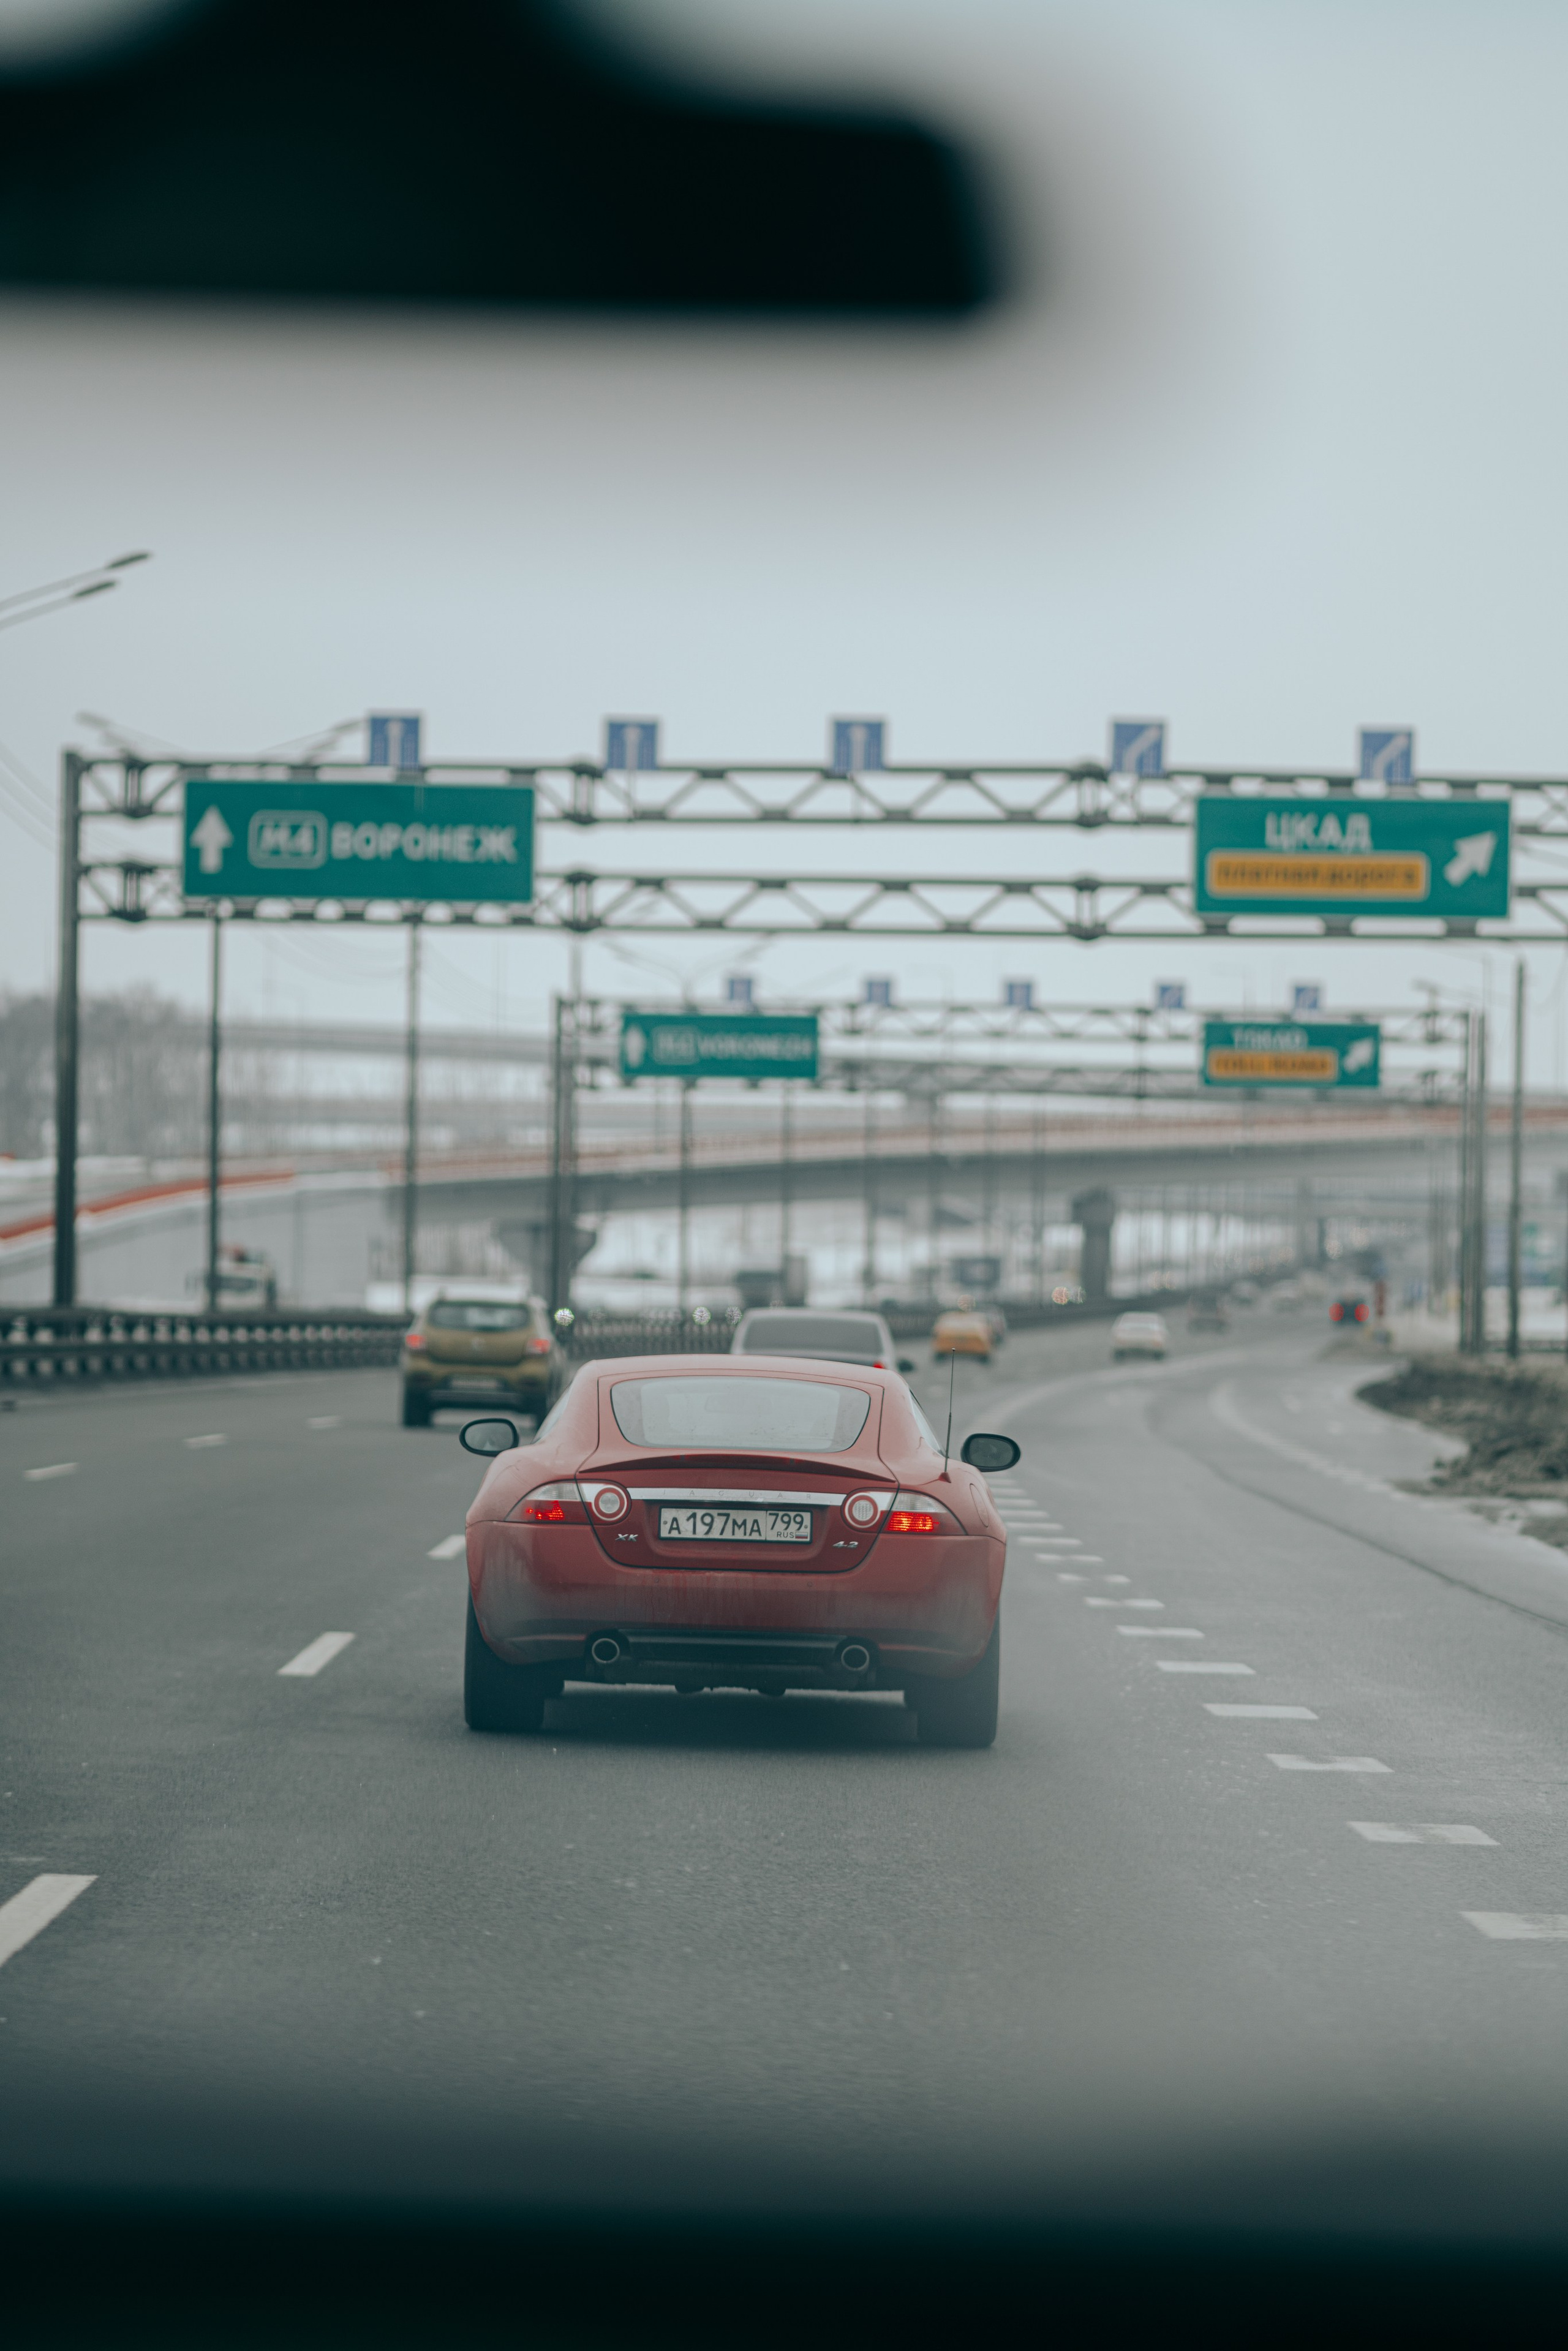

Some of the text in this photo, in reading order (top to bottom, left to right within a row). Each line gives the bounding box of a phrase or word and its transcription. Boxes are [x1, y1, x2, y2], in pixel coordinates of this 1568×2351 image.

[1265, 812, 1373, 851] ЦКАД
[331, 821, 518, 862] ВОРОНЕЖ
[663, 1489, 811, 1500] JAGUAR
[768, 1512, 804, 1531] 799
[614, 1533, 639, 1542] XK
